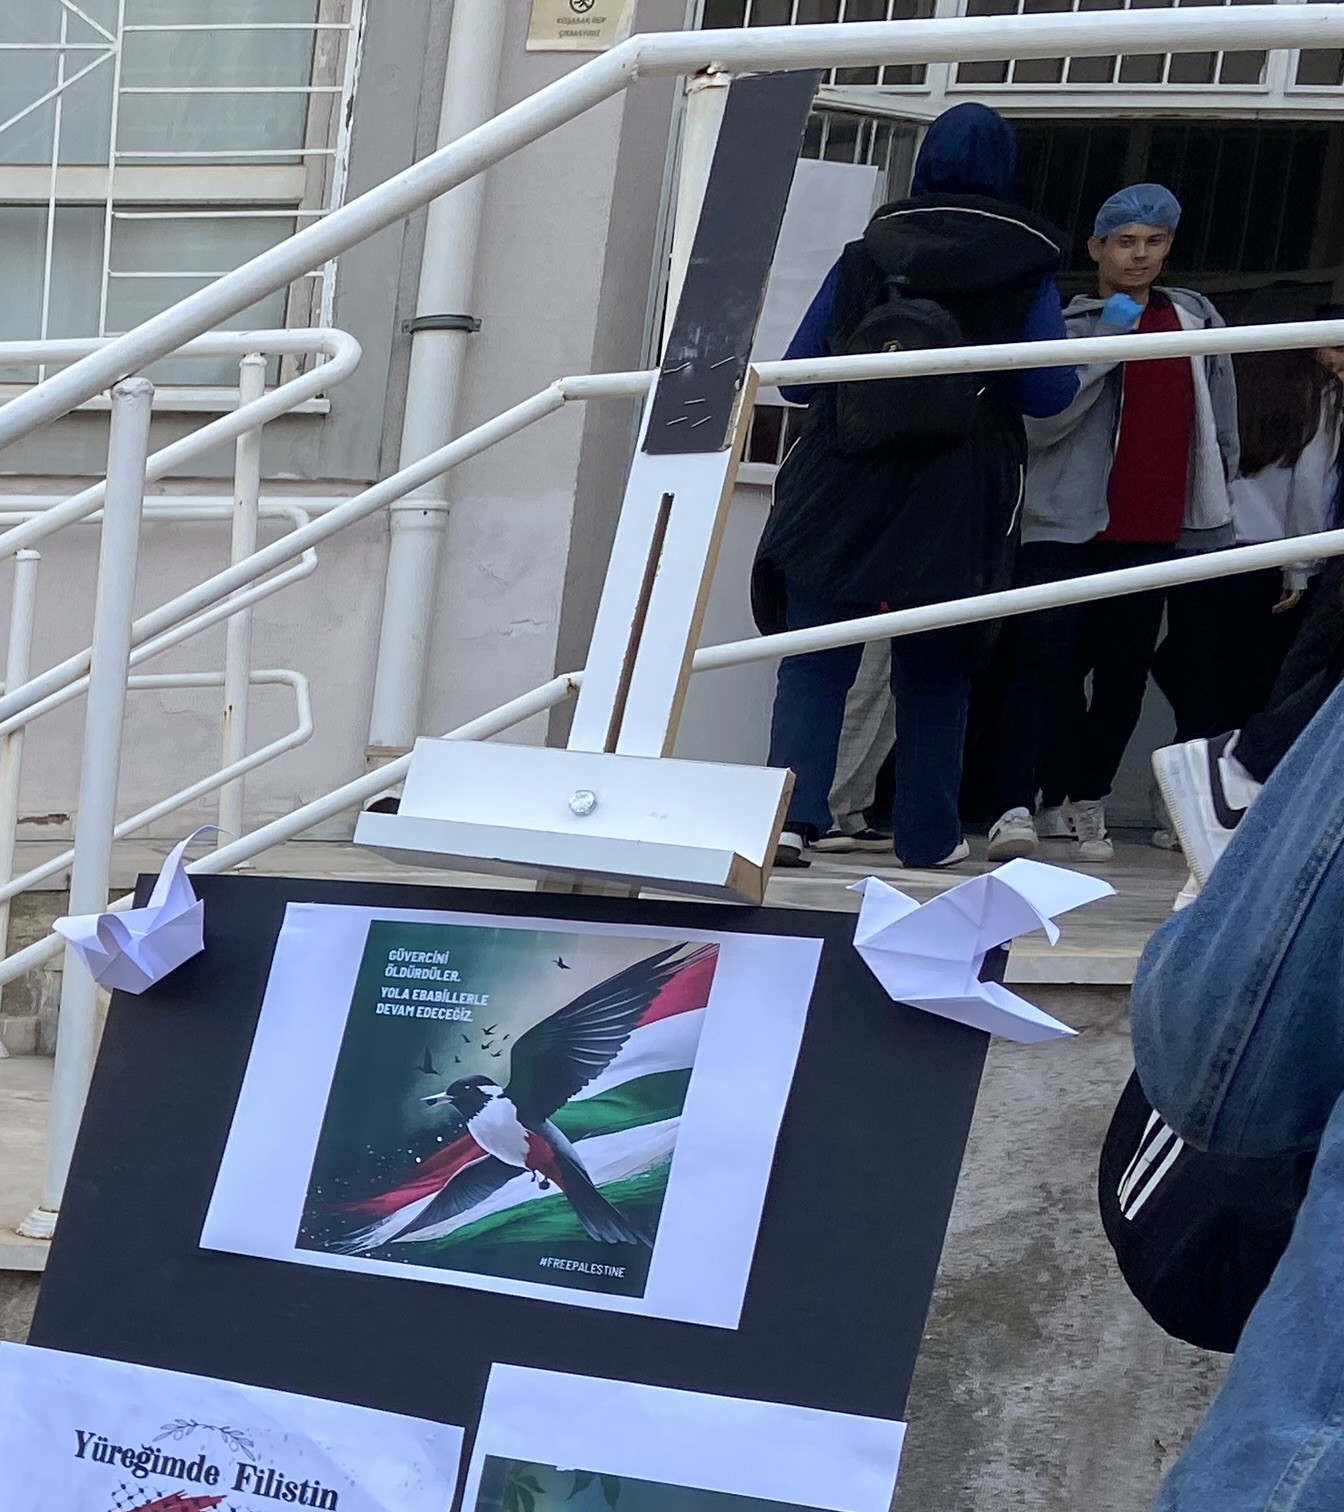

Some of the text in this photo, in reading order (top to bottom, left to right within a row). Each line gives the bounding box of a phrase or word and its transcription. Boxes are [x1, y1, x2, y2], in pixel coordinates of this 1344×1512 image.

[388, 947, 451, 965] GÜVERCİNİ
[384, 963, 462, 982] ÖLDÜRDÜLER.
[381, 986, 490, 1006] YOLA EBABİLLERLE
[375, 1002, 415, 1018] DEVAM
[539, 1257, 627, 1278] #FREEPALESTINE
[73, 1428, 340, 1512] Yüreğimde Filistin
